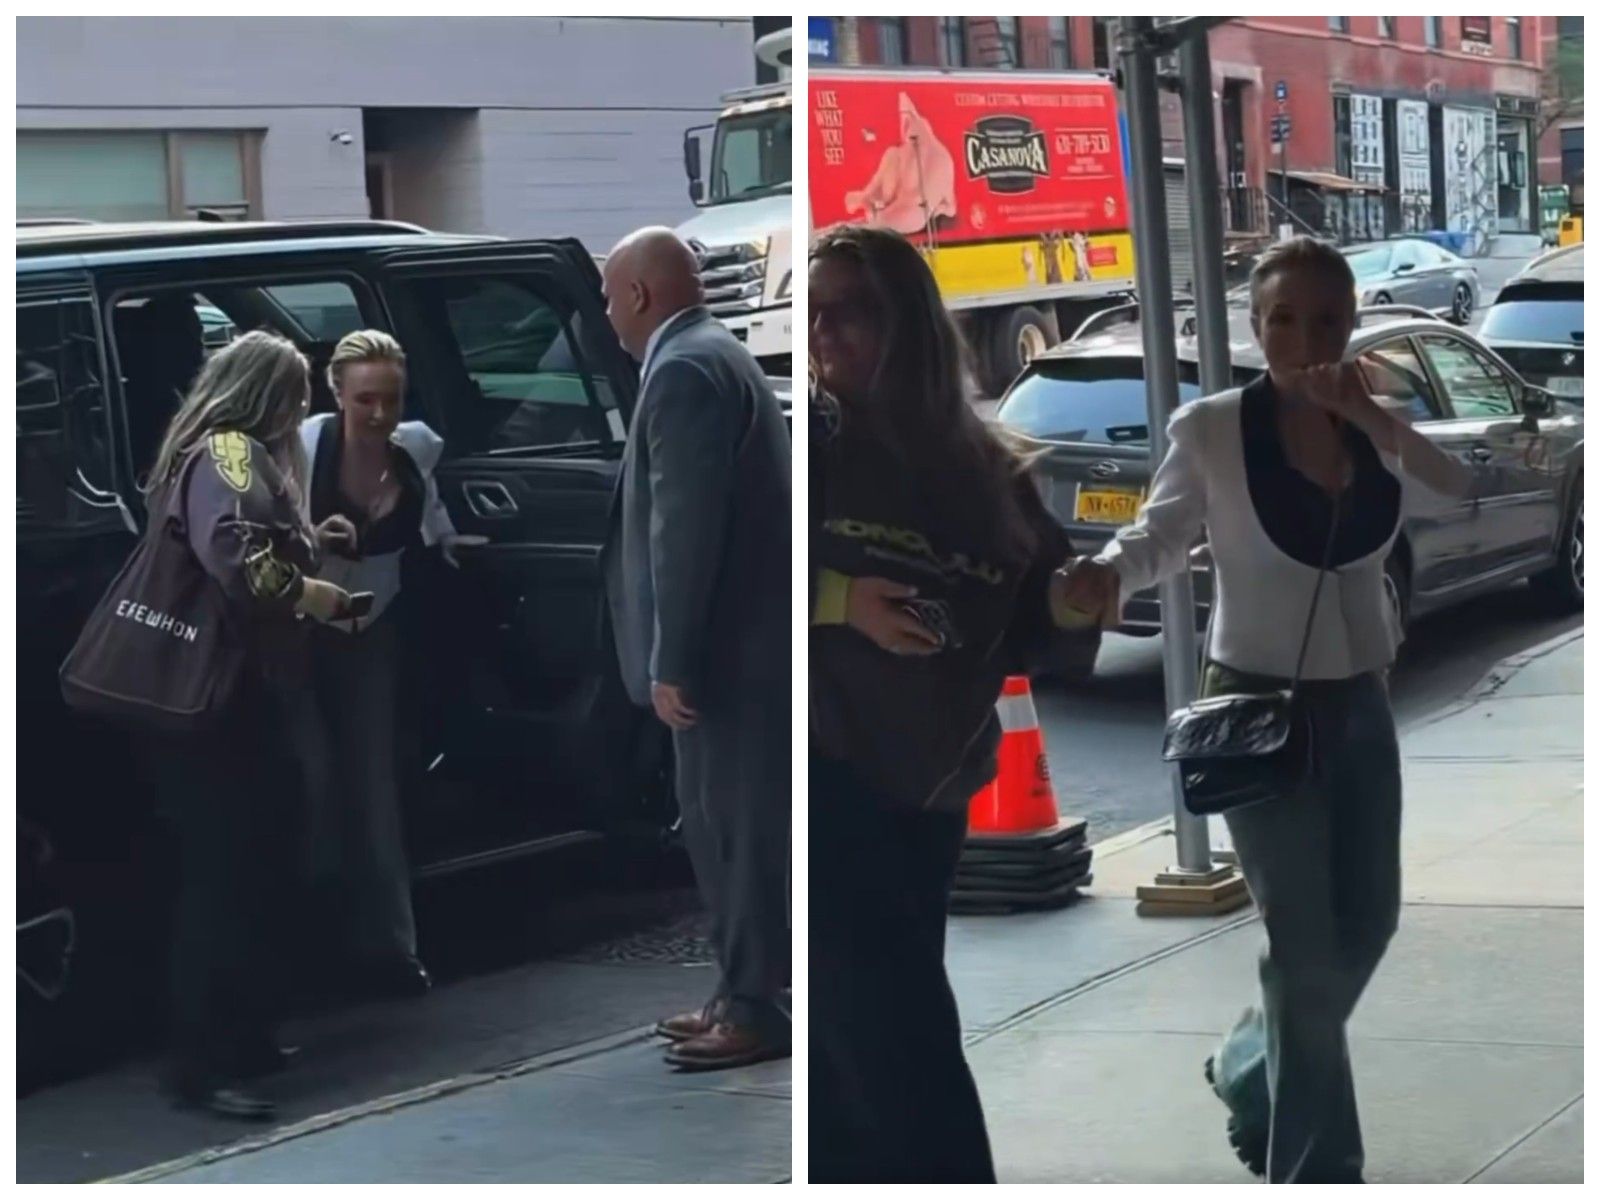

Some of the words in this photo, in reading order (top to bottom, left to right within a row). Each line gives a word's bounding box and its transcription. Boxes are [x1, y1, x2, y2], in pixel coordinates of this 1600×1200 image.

[816, 90, 838, 109] LIKE
[814, 109, 843, 127] WHAT
[820, 128, 843, 146] YOU
[966, 136, 1048, 175] CASANOVA
